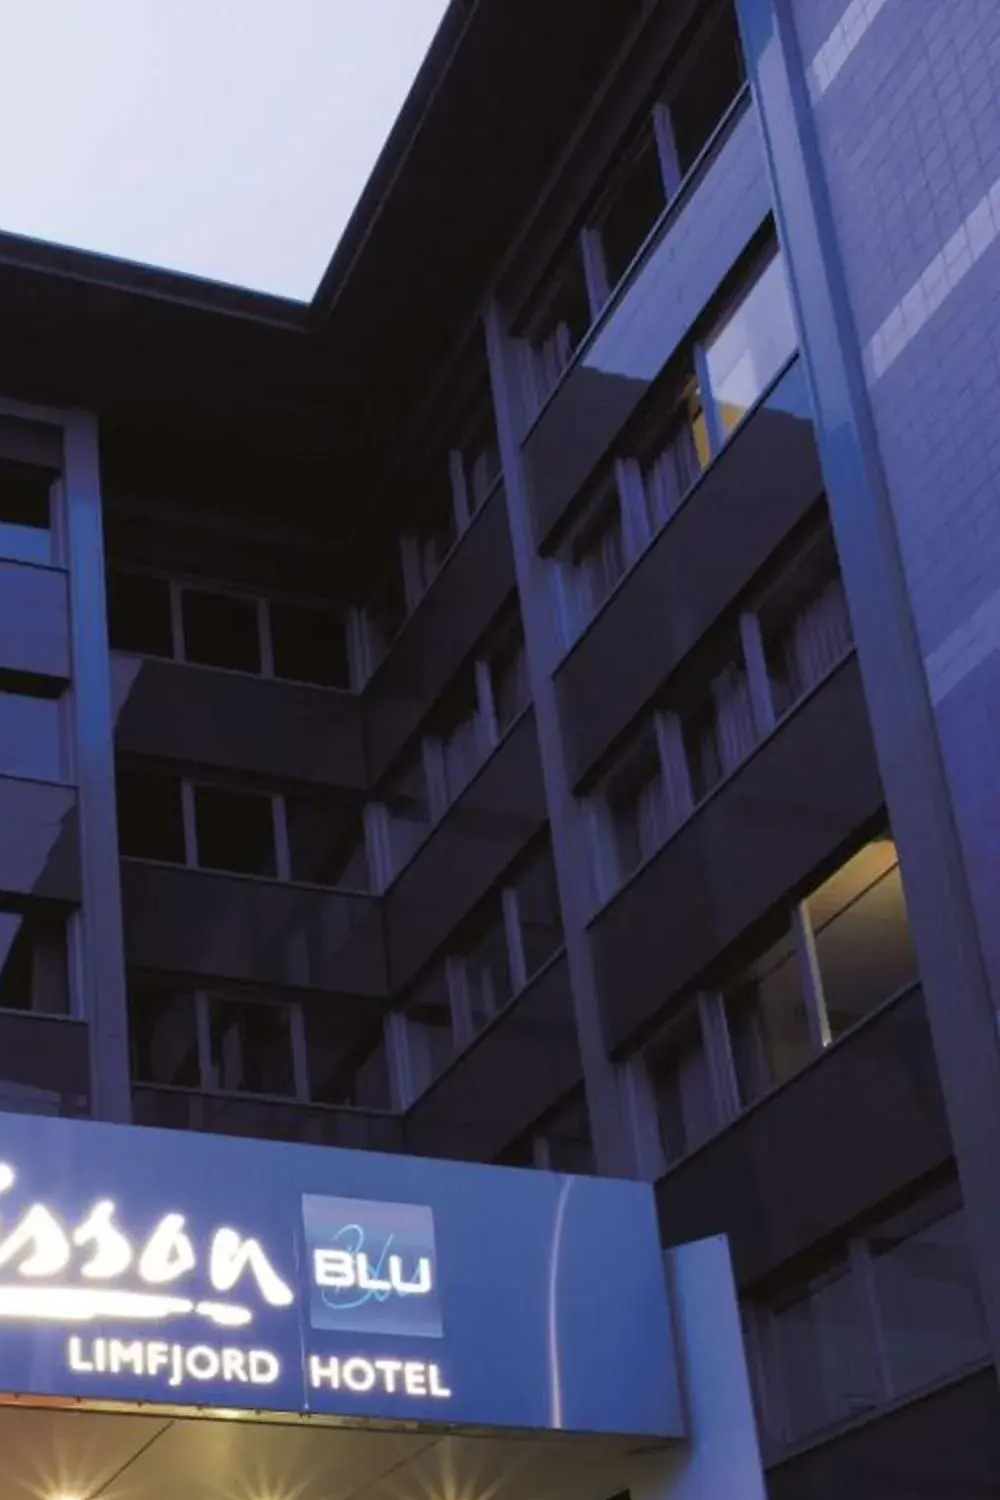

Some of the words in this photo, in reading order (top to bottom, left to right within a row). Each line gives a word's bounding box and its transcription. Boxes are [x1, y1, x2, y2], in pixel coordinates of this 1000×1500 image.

[313, 1248, 432, 1293] BLU
[69, 1340, 280, 1386] LIMFJORD
[309, 1354, 452, 1397] HOTEL
